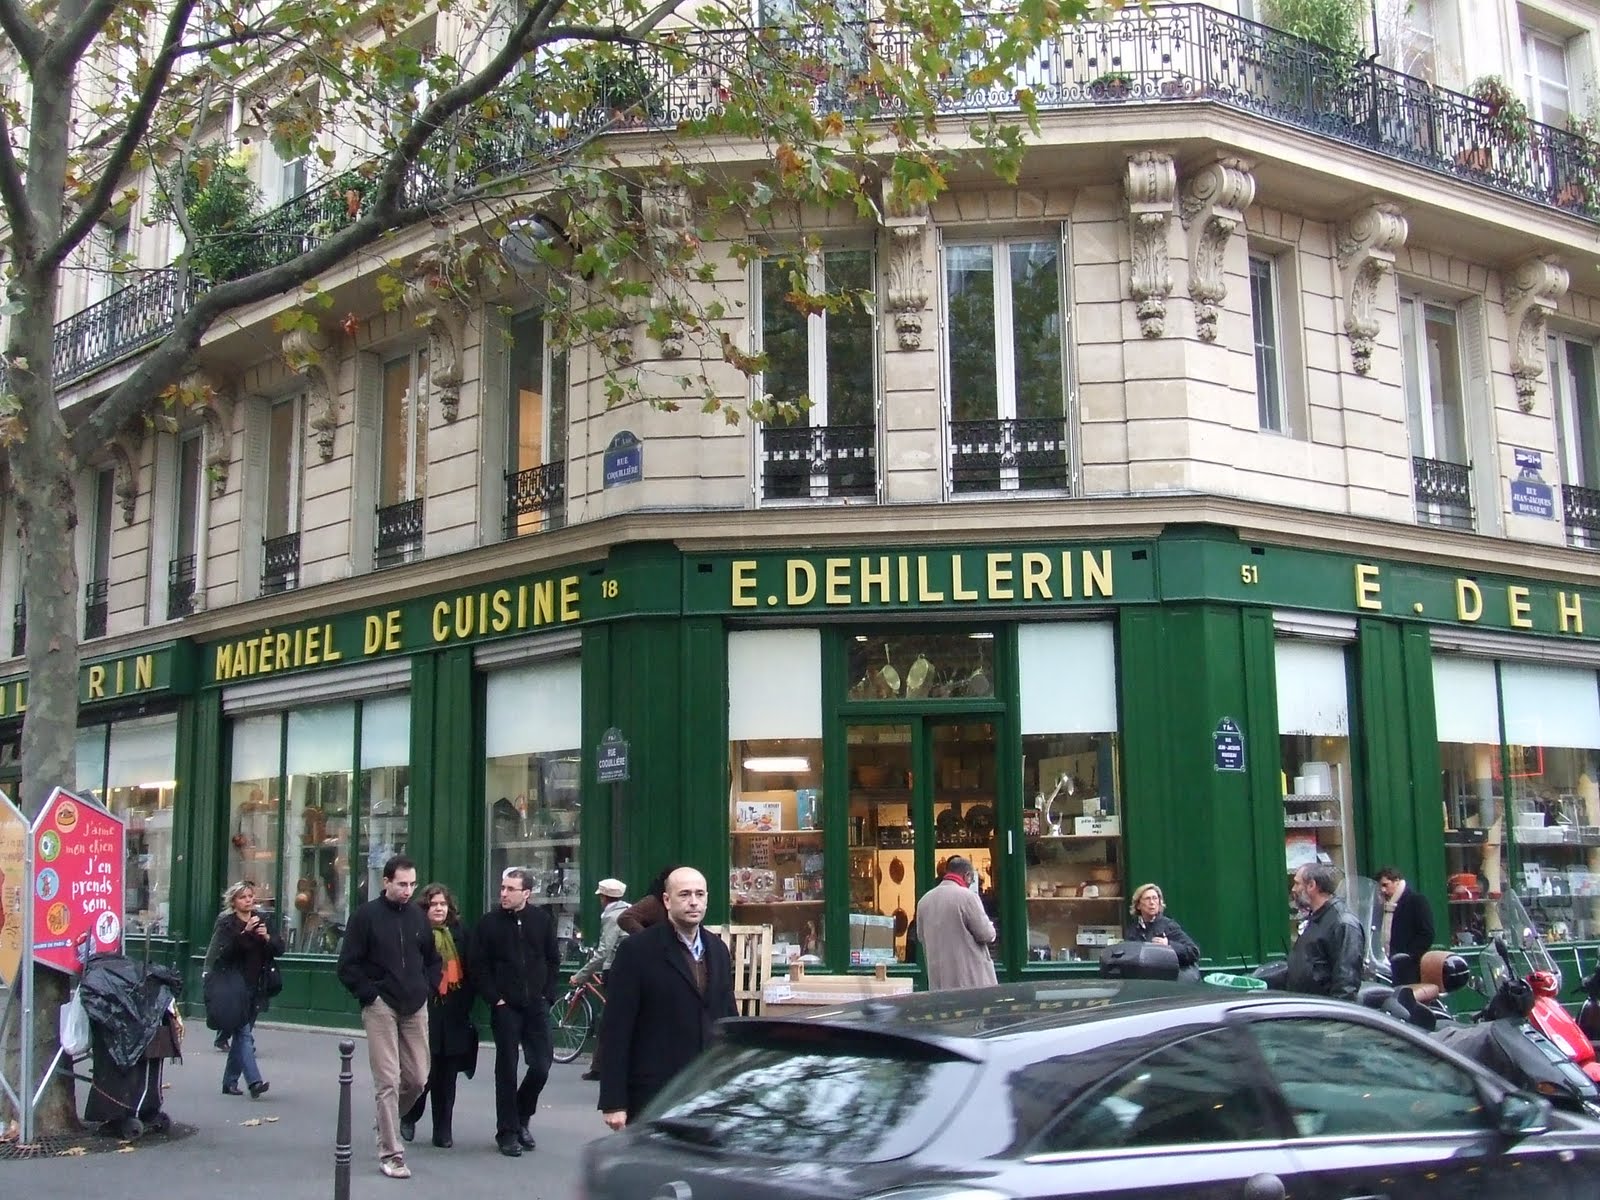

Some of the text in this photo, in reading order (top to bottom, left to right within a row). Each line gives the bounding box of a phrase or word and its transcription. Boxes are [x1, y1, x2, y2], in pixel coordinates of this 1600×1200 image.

[616, 456, 629, 467] RUE
[1525, 487, 1537, 496] RUE
[1240, 564, 1259, 584] 51
[601, 579, 618, 599] 18
[364, 610, 401, 655] DE
[432, 575, 581, 642] CUISINE
[83, 820, 115, 837] J'aime
[66, 839, 114, 856] mon chien
[85, 855, 112, 875] J'en
[72, 876, 112, 900] prends
[83, 893, 112, 915] soin.
